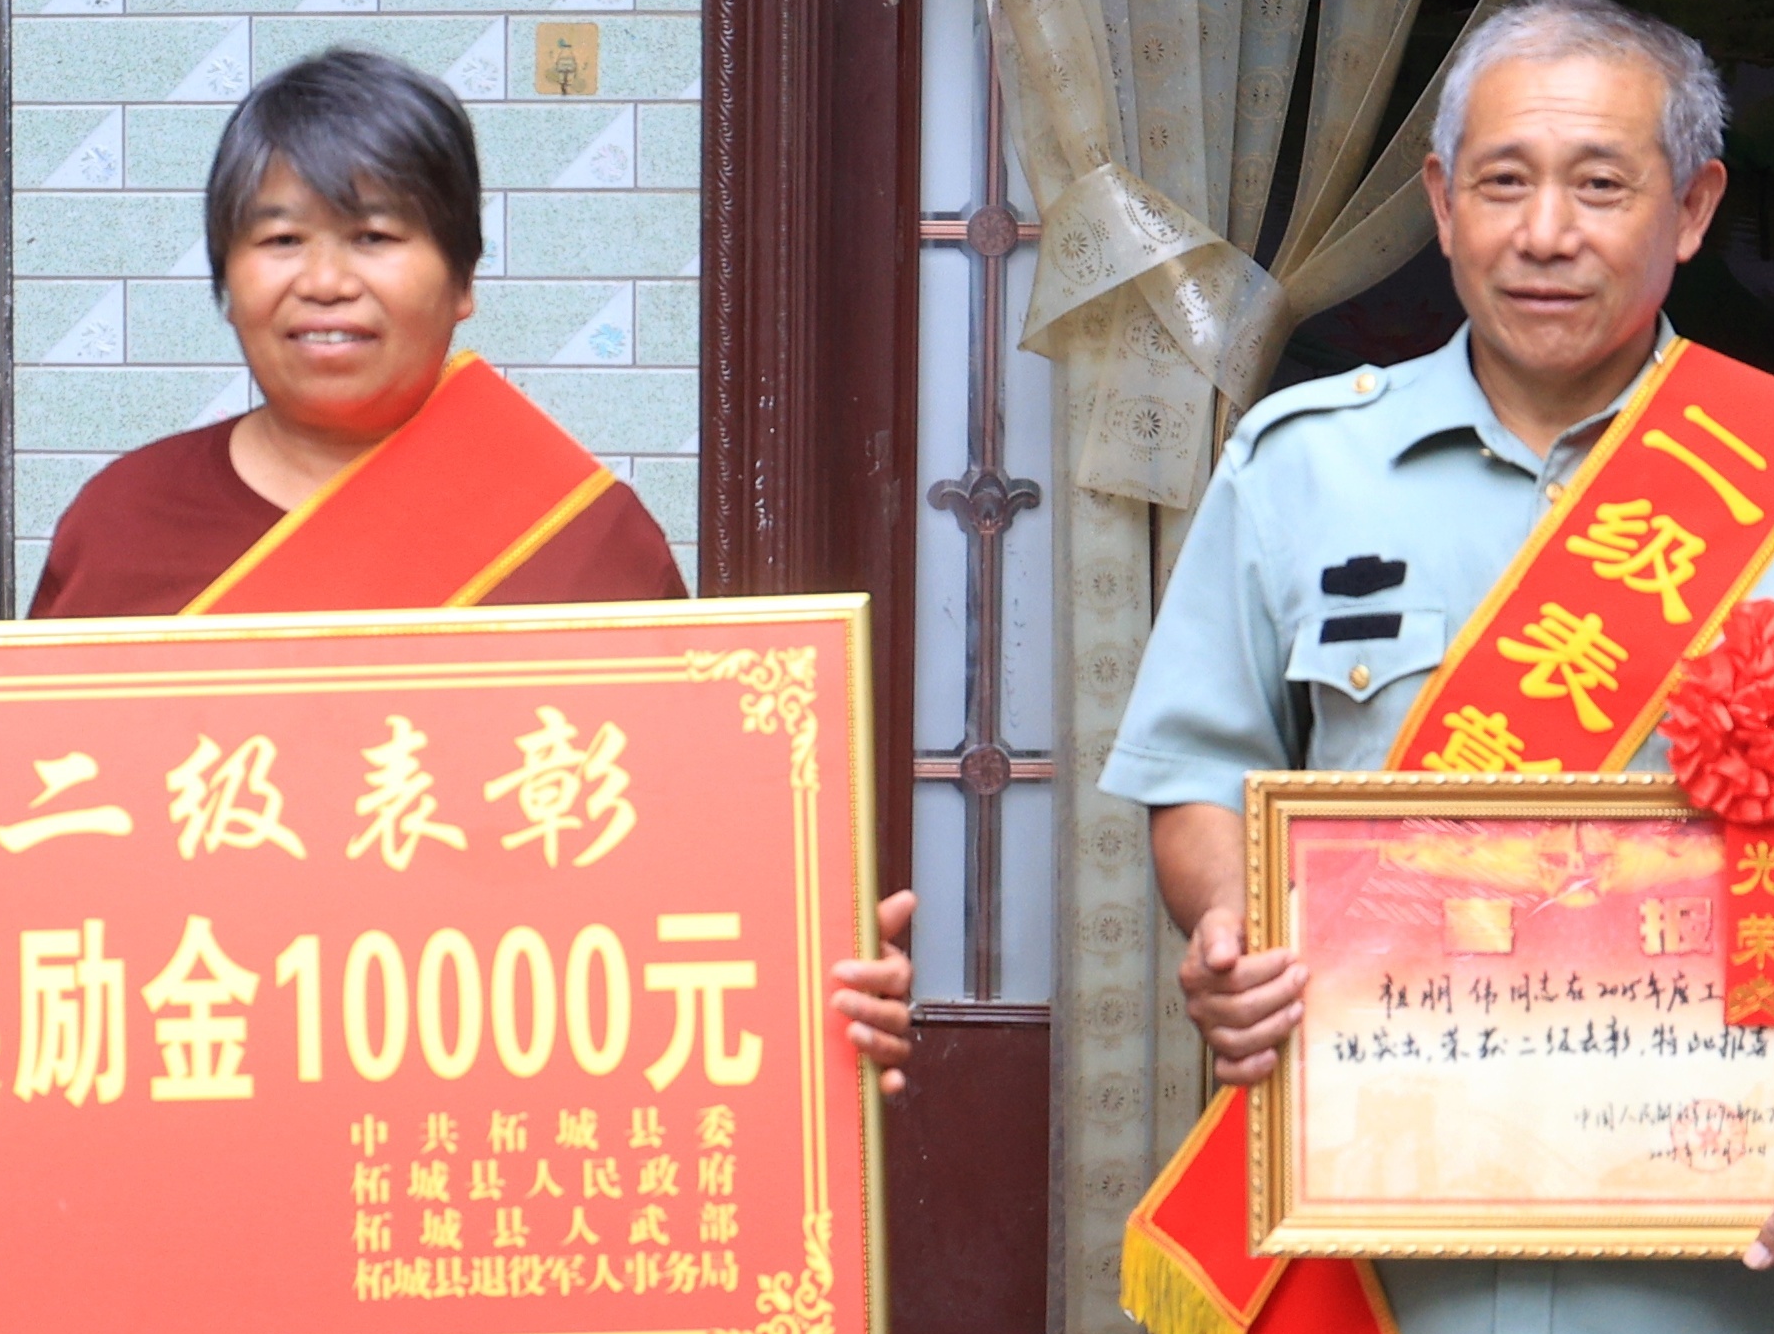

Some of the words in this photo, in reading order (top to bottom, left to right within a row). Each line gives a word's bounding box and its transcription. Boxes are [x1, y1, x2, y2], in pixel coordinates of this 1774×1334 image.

[349, 1104, 737, 1157] 中共柘城县委
[349, 1152, 738, 1205] 柘城县人民政府
[351, 1202, 739, 1254] 柘城县人武部
[353, 1249, 740, 1302] 柘城县退役军人事务局
